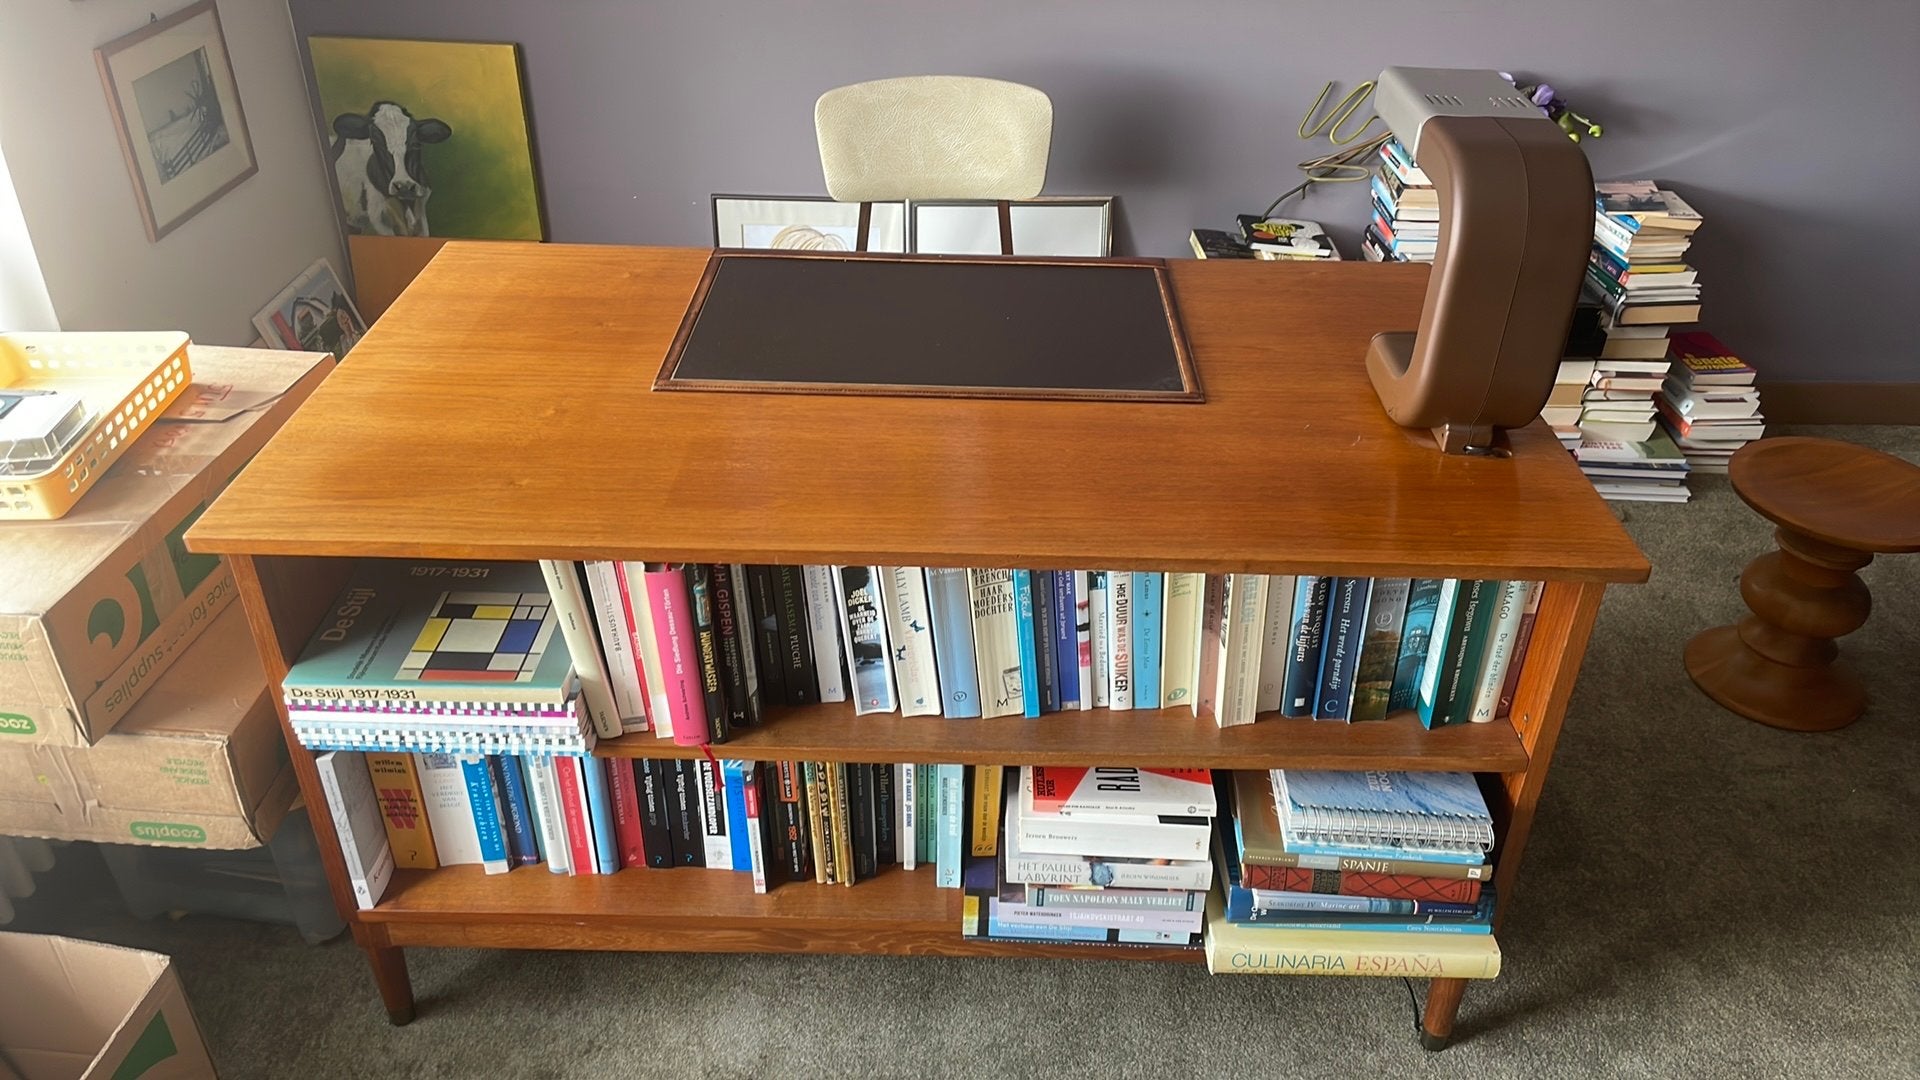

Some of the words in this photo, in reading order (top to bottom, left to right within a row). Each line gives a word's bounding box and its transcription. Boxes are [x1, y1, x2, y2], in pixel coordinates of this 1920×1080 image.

[410, 566, 489, 578] 1917-1931
[975, 570, 1008, 586] FRENCH
[851, 588, 867, 599] JOEL
[980, 585, 1003, 598] HAAR
[1115, 583, 1126, 598] HOE
[1317, 582, 1327, 605] OLOV
[1340, 578, 1356, 614] Speerstra
[848, 595, 873, 606] DICKER
[898, 592, 911, 622] LAMB
[973, 593, 1013, 609] MOEDERS
[188, 601, 208, 632] for
[320, 617, 354, 641] De
[339, 588, 376, 617] Stijl
[661, 588, 677, 635] Dessau-Törten
[715, 588, 733, 635] GISPEN
[782, 589, 797, 633] HALSEMA
[975, 603, 1013, 619] DOCHTER
[1115, 599, 1128, 625] DUUR
[1301, 609, 1311, 624] van
[1460, 599, 1480, 633] Isegawa
[1116, 626, 1125, 642] WAS
[1143, 628, 1150, 636] De
[1299, 624, 1311, 634] de
[1308, 608, 1324, 649] ENQUIST
[1339, 618, 1349, 633] Het
[1334, 634, 1346, 657] wrede
[1497, 632, 1508, 643] De
[670, 635, 682, 663] Siedlung
[789, 634, 802, 669] PLUCHE
[1117, 643, 1125, 652] DE
[1293, 634, 1310, 662] lijfarts
[1494, 644, 1504, 658] stad
[675, 663, 683, 674] Die
[699, 630, 717, 692] HUNDERTWASSER
[1490, 659, 1501, 671] der
[103, 645, 164, 714] supplies
[1114, 653, 1128, 691] SUIKER
[1327, 657, 1344, 690] paradijs
[291, 689, 313, 698] De
[314, 688, 345, 700] Stijl
[349, 689, 416, 699] 1917-1931
[1483, 672, 1497, 699] blinden
[1477, 708, 1490, 717] M
[713, 717, 722, 738] TASCHEN
[499, 756, 508, 771] VAN
[701, 761, 710, 771] DE
[501, 771, 515, 802] DANTZIG
[643, 774, 654, 794] Vijftig
[675, 773, 685, 792] Vijftig
[1046, 780, 1055, 797] FOR
[477, 766, 483, 775] DE
[494, 843, 500, 851] DE
[647, 794, 655, 812] tinten
[678, 792, 686, 810] tinten
[702, 771, 719, 834] VOEDSELZANDLOPER
[469, 780, 489, 841] Kruistochten
[508, 801, 522, 834] AFGROND
[136, 826, 200, 839] zooplus
[1018, 862, 1037, 872] HET
[1041, 863, 1082, 873] PAULUS
[1342, 859, 1389, 873] SPANJE
[1049, 894, 1072, 903] TOEN
[1073, 894, 1120, 905] NAPOLEON
[1120, 895, 1145, 905] MALY
[1147, 896, 1184, 907] VERLIET
[1423, 925, 1461, 933] Nooteboom
[1231, 953, 1346, 970] CULINARIA
[1355, 954, 1444, 972] ESPAÑA
